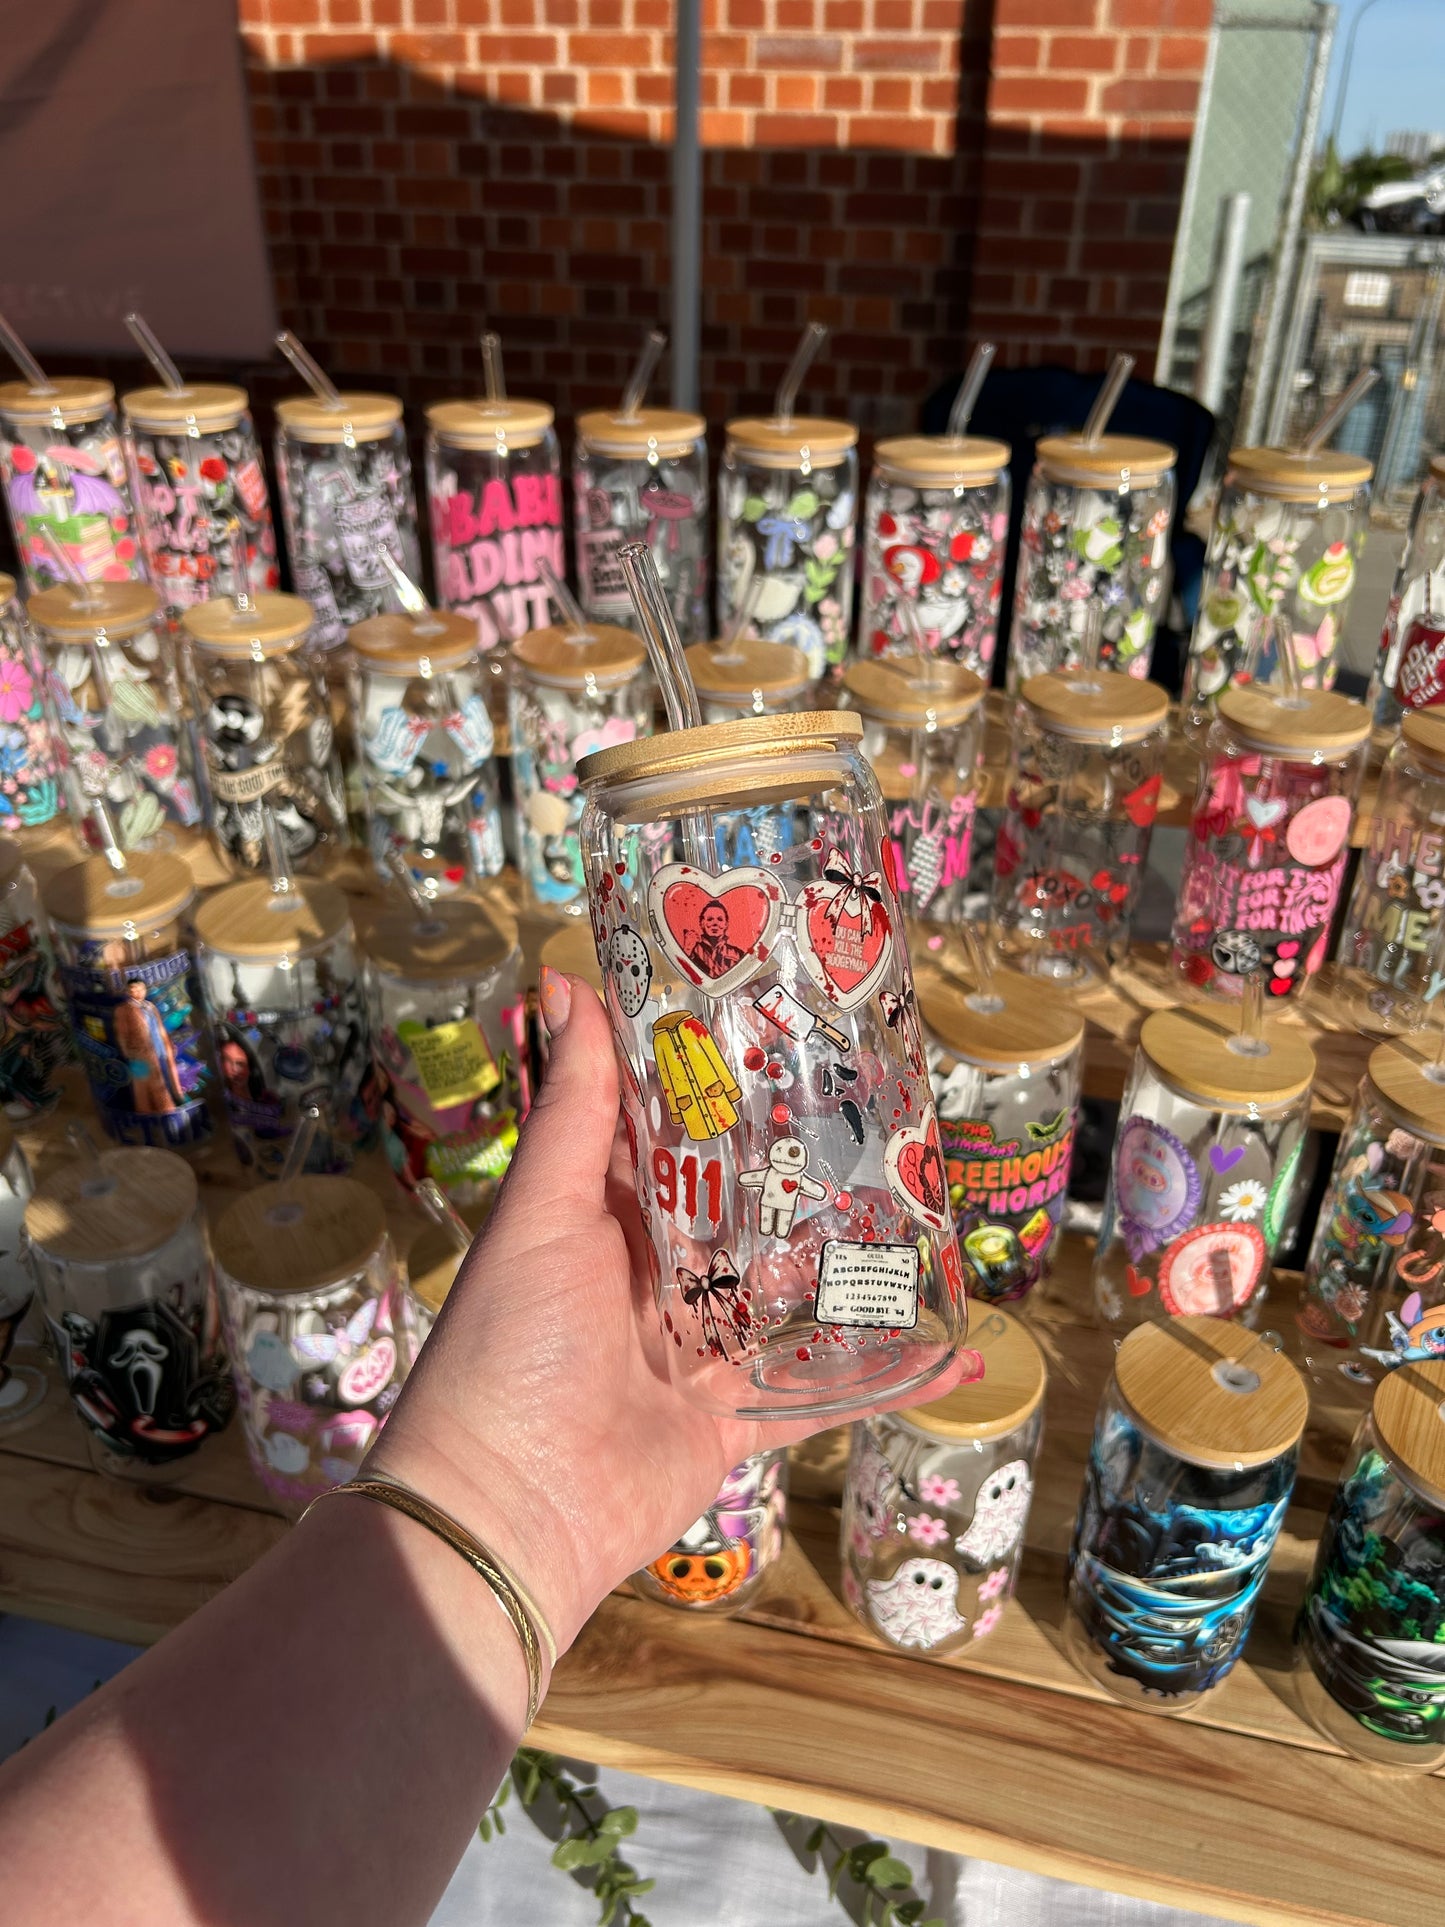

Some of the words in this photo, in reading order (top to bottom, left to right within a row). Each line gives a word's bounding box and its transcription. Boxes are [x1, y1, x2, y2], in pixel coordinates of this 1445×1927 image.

[1240, 868, 1285, 893] FOR
[1237, 886, 1280, 912] FOR
[1235, 907, 1278, 931] FOR
[849, 943, 864, 959] THE
[825, 952, 869, 975] BOOGEYMAN
[960, 1121, 992, 1138] THE
[653, 1147, 722, 1234] 911
[845, 1292, 898, 1303] 1234567890
